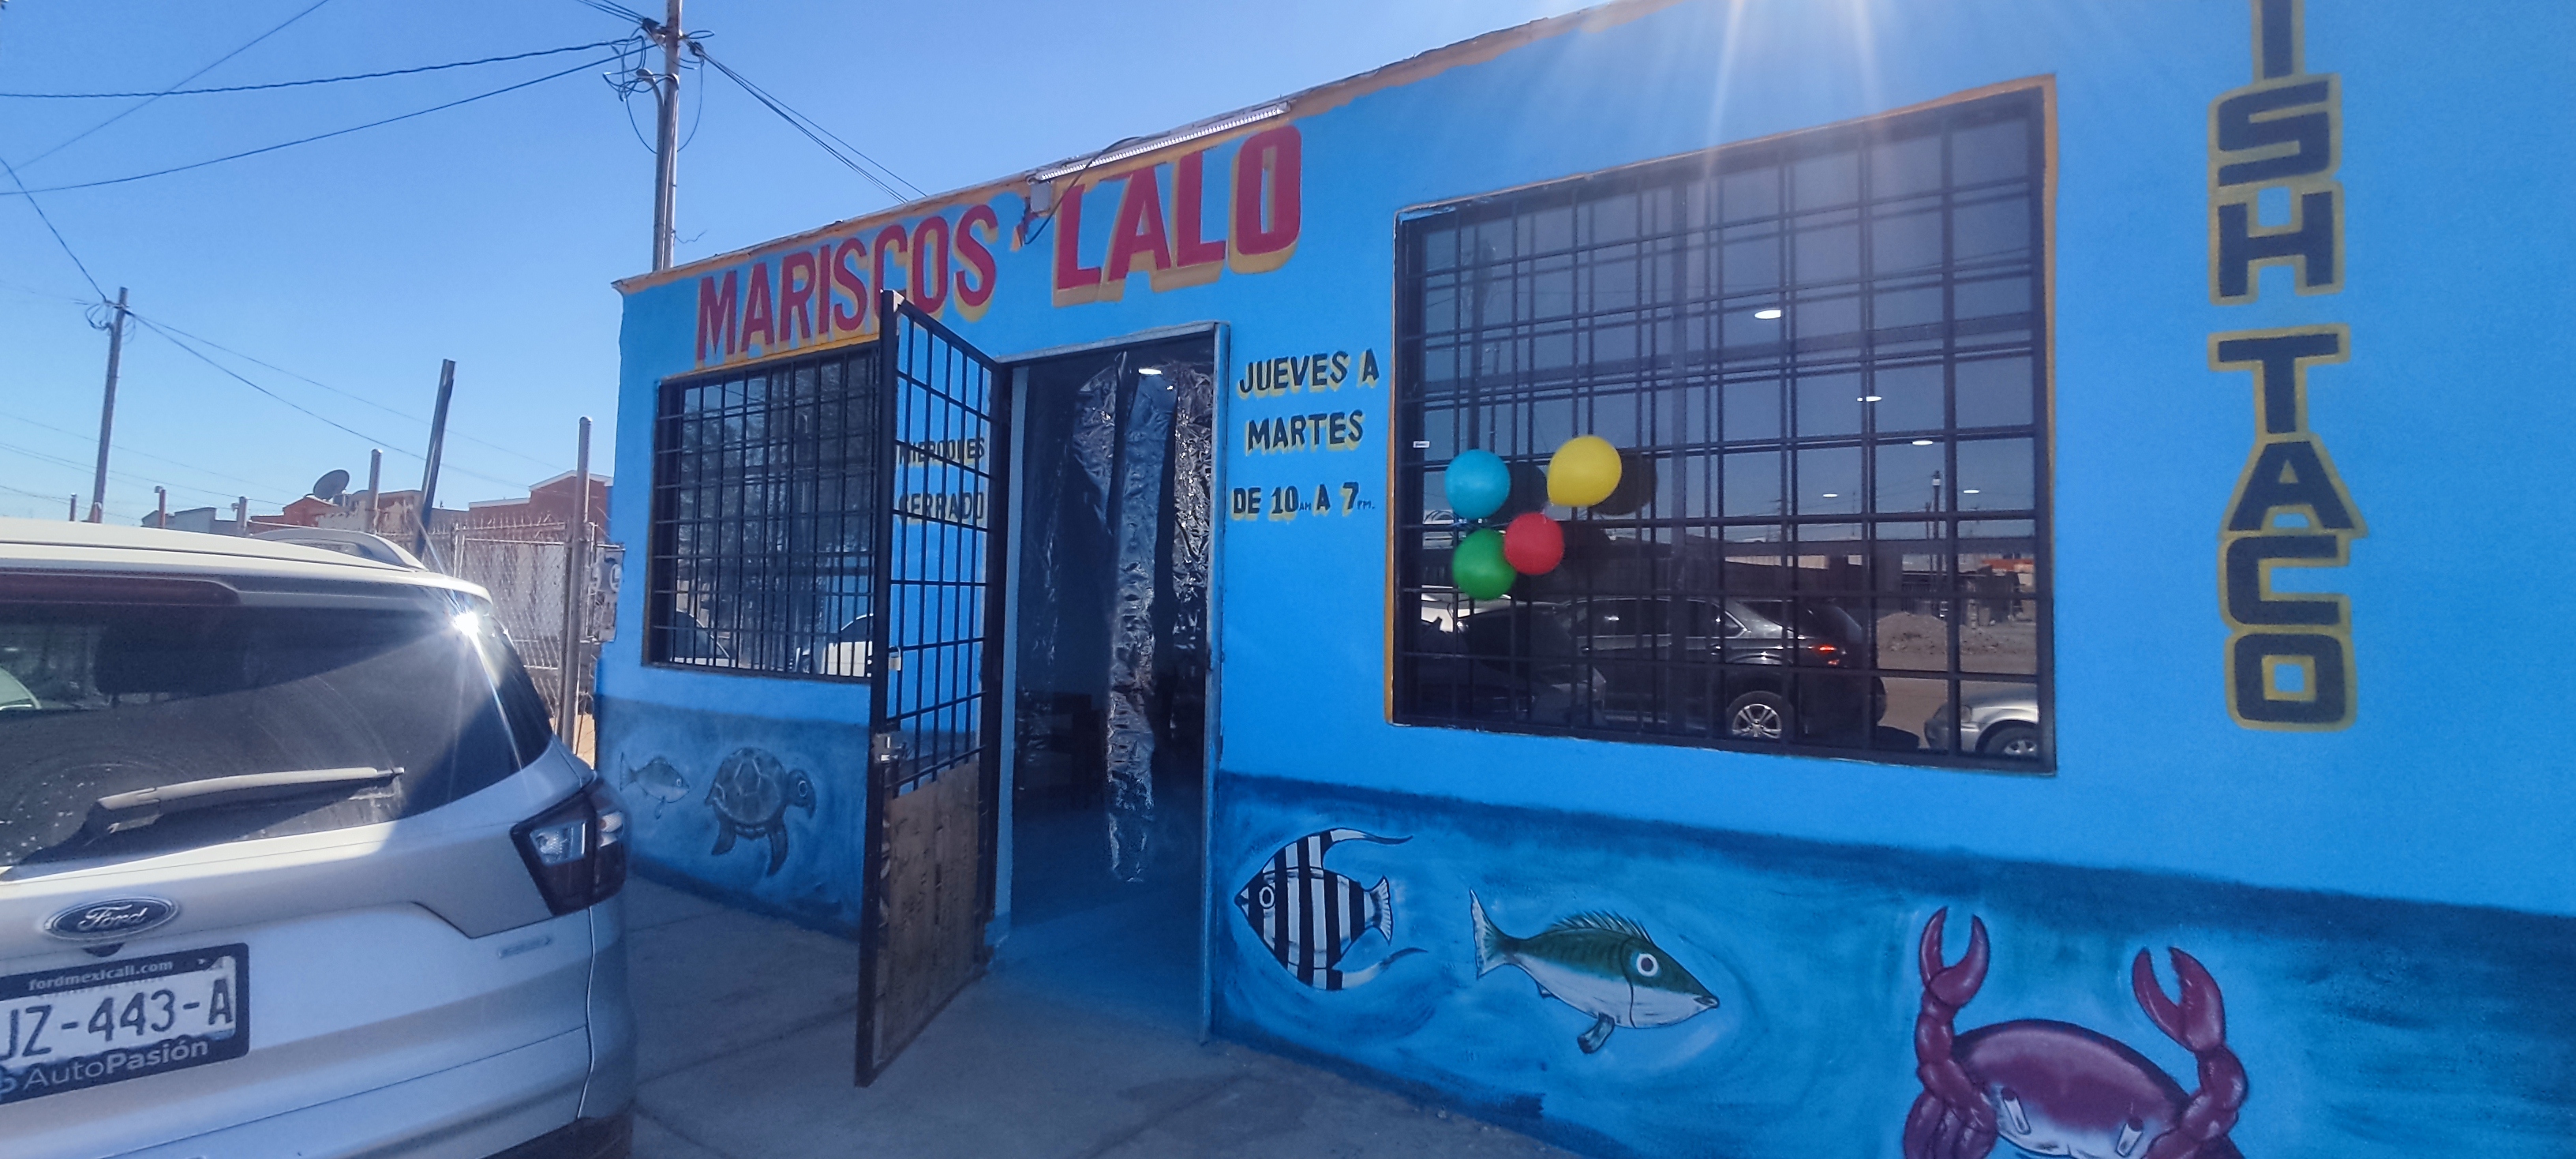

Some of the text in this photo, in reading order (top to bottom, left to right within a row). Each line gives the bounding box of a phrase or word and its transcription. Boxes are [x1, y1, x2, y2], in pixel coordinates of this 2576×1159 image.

[696, 204, 998, 364] MARISCOS
[1238, 348, 1380, 395] JUEVES A
[1247, 409, 1364, 453] MARTES
[1232, 486, 1261, 516] DE
[1315, 484, 1331, 513] A
[2213, 328, 2363, 727] TACO
[77, 904, 148, 931] Ford
[28, 960, 174, 991] fordmexicali.com
